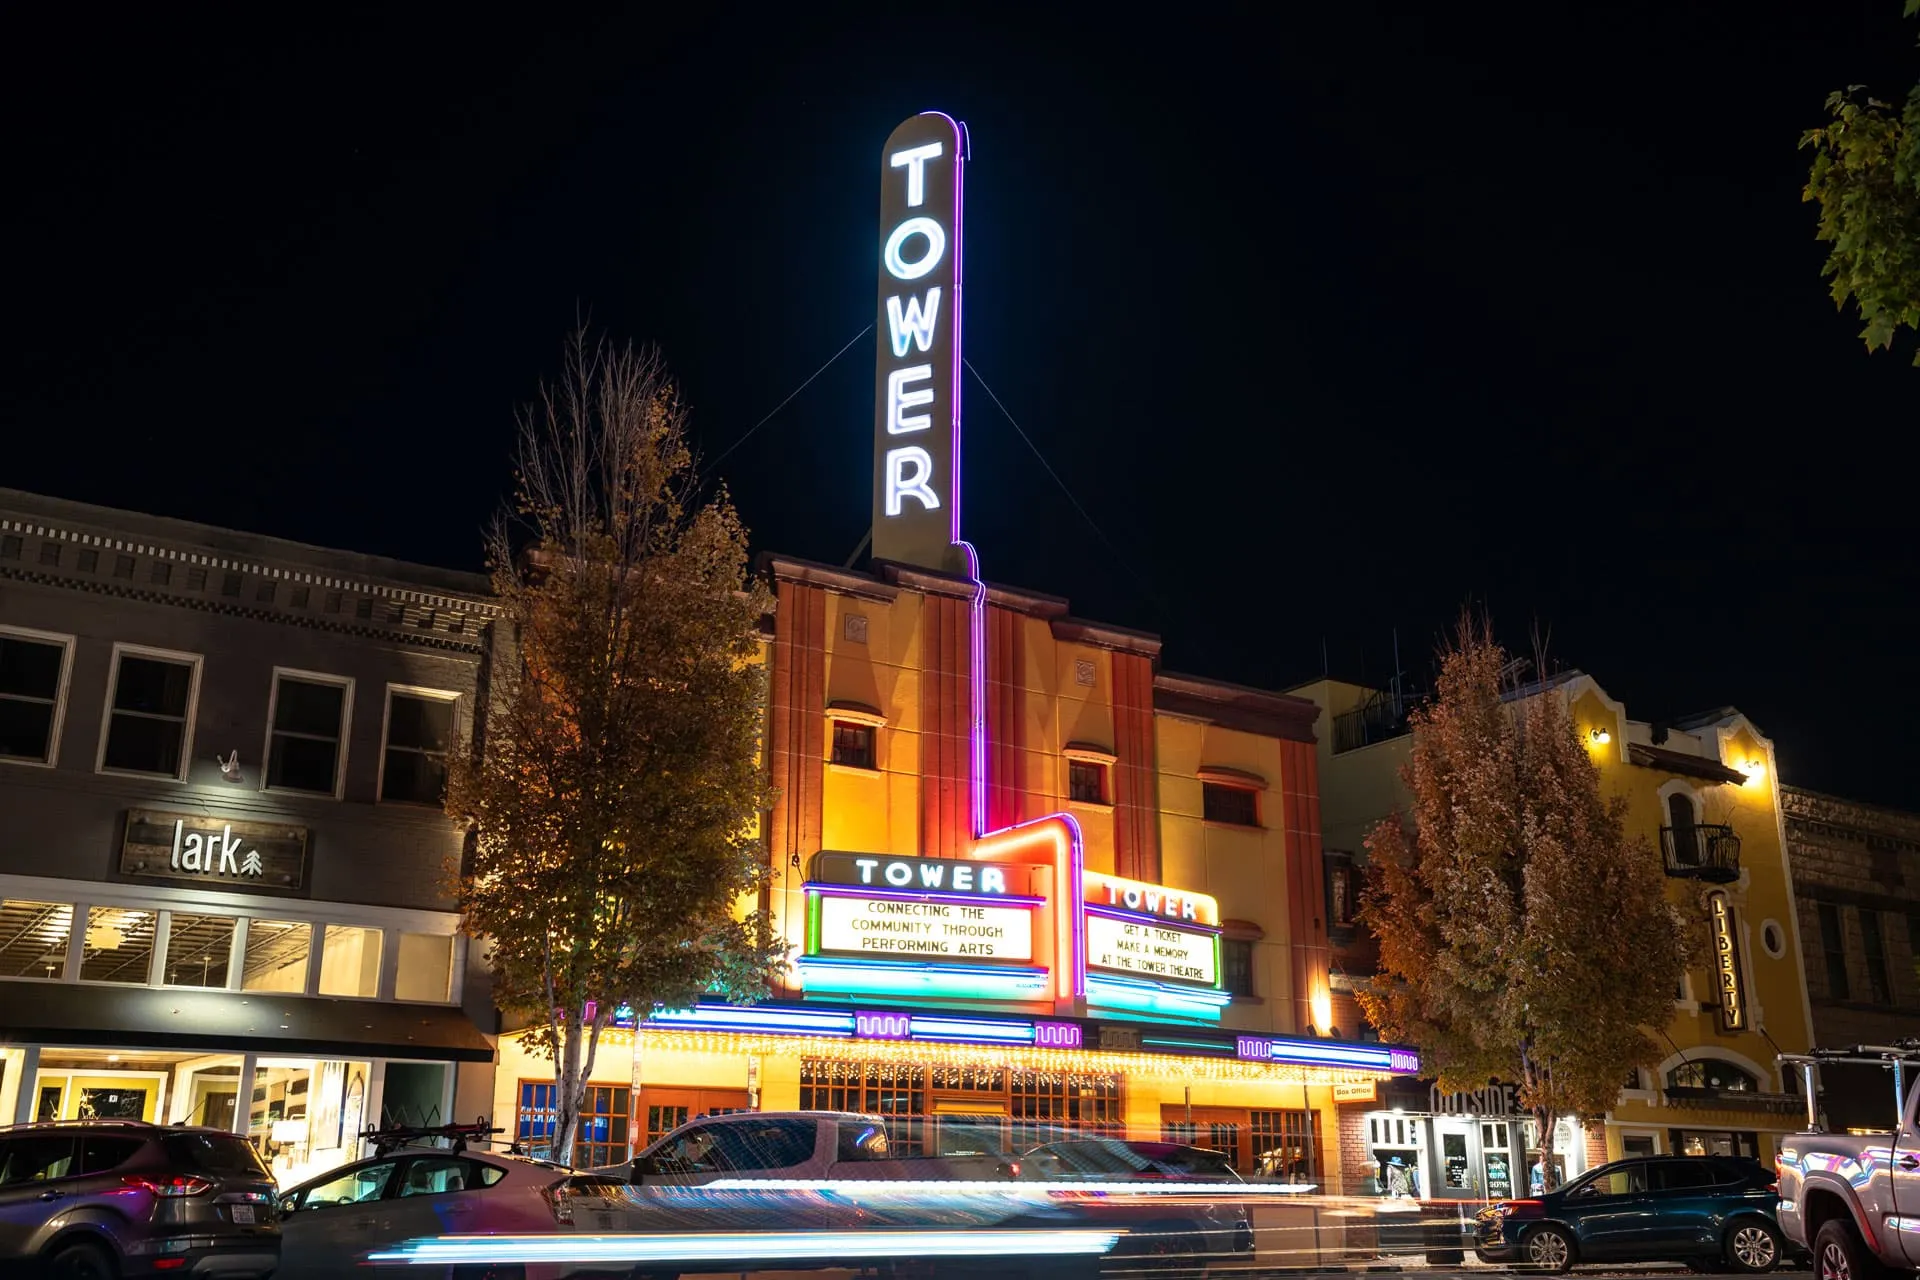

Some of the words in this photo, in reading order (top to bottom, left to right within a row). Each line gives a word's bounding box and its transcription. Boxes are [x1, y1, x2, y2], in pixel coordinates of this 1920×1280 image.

[884, 141, 945, 517] TOWER
[171, 819, 242, 874] lark
[856, 859, 1006, 893] TOWER
[868, 902, 950, 917] CONNECTING
[960, 908, 985, 919] THE
[1103, 882, 1197, 920] TOWER
[852, 919, 932, 934] COMMUNITY
[942, 924, 1004, 938] THROUGH
[1124, 925, 1140, 936] GET
[1144, 928, 1149, 937] A
[1155, 929, 1182, 943] TICKET
[862, 937, 949, 953] PERFORMING
[958, 943, 994, 955] ARTS
[1117, 940, 1140, 953] MAKE
[1144, 944, 1149, 954] A
[1154, 946, 1189, 960] MEMORY
[1102, 954, 1112, 965] AT
[1117, 956, 1132, 968] THE
[1138, 959, 1166, 973] TOWER
[1170, 964, 1204, 979] THEATRE
[1714, 898, 1738, 1026] LIBERTY
